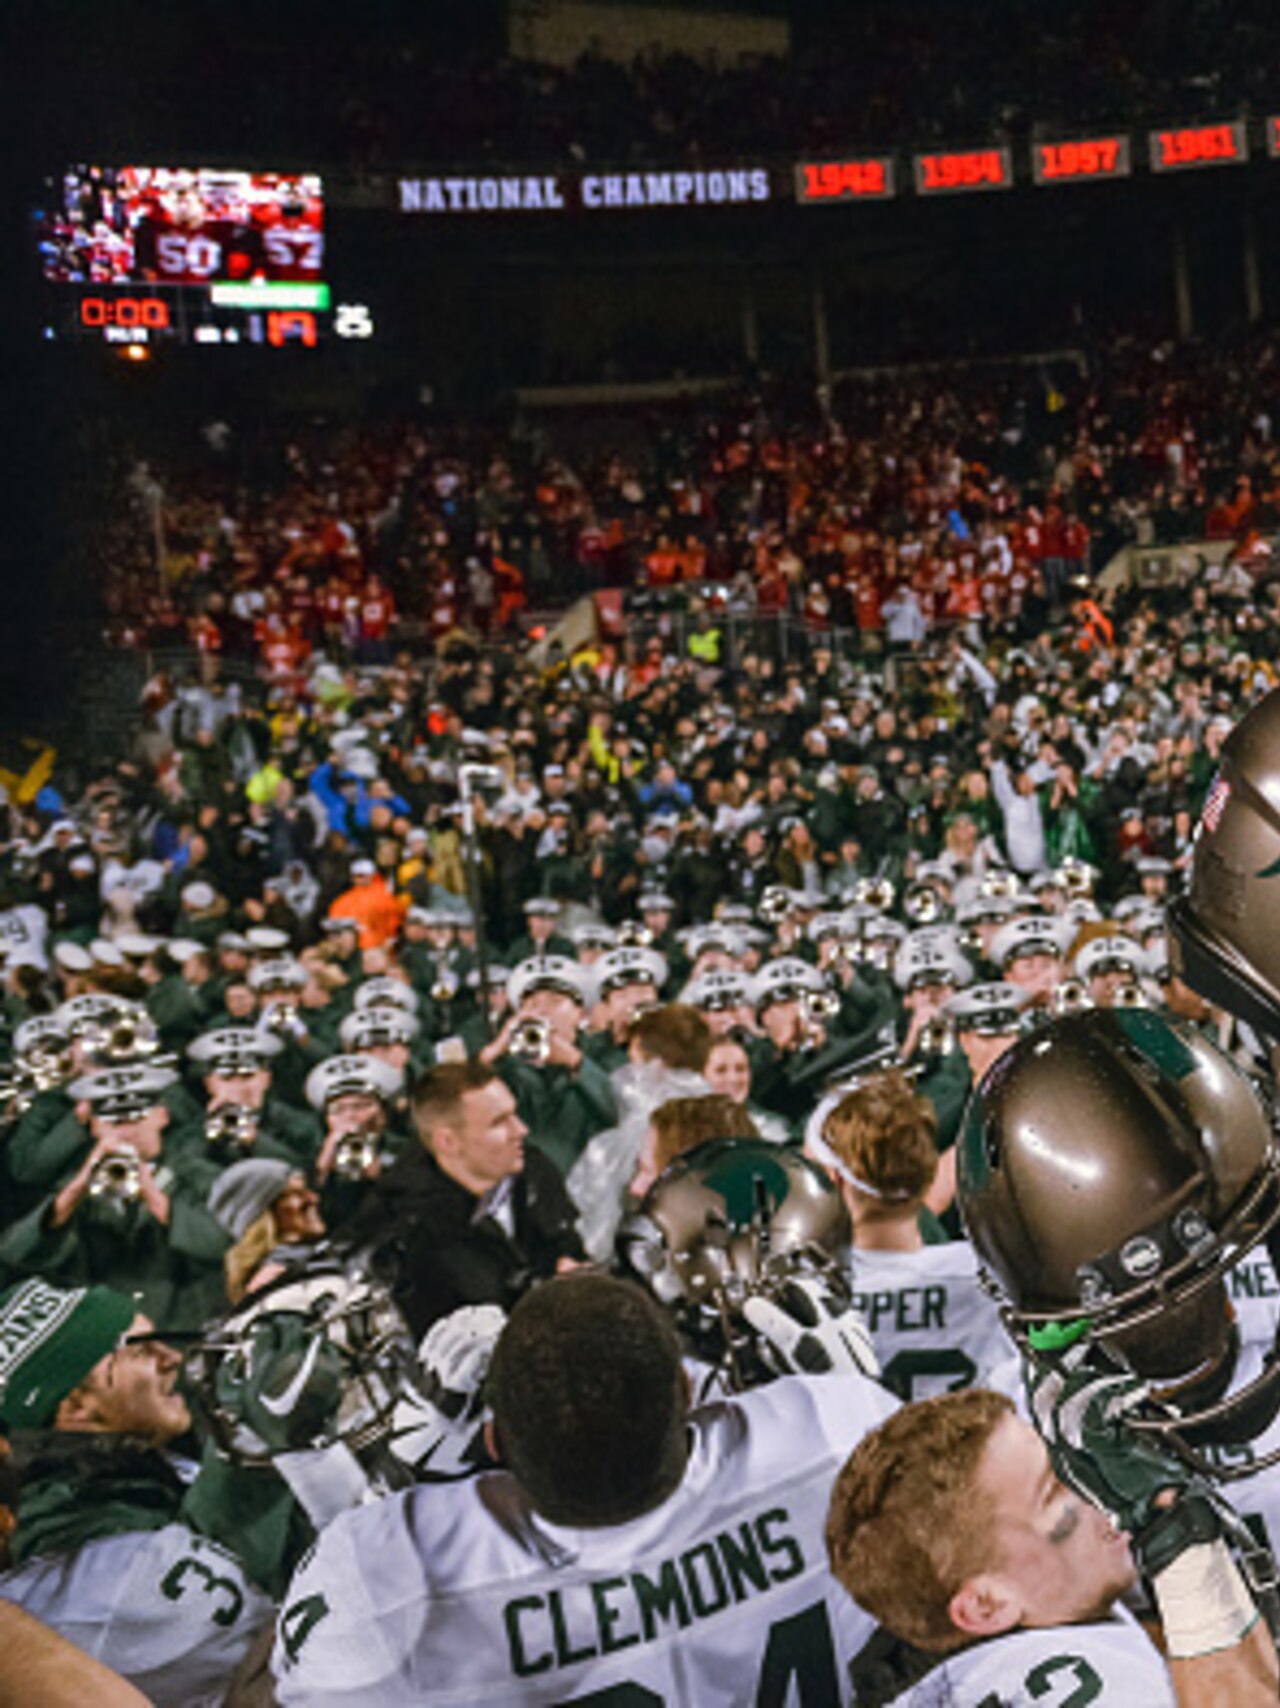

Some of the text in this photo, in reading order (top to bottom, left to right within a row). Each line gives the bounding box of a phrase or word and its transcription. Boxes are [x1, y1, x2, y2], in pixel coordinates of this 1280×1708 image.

[399, 177, 564, 211] NATIONAL
[582, 169, 769, 208] CHAMPIONS
[803, 161, 885, 197] 1942
[920, 151, 1004, 188] 1954
[1040, 139, 1120, 178] 1957
[81, 298, 169, 327] 0:00
[504, 1507, 806, 1679] CLEMONS
